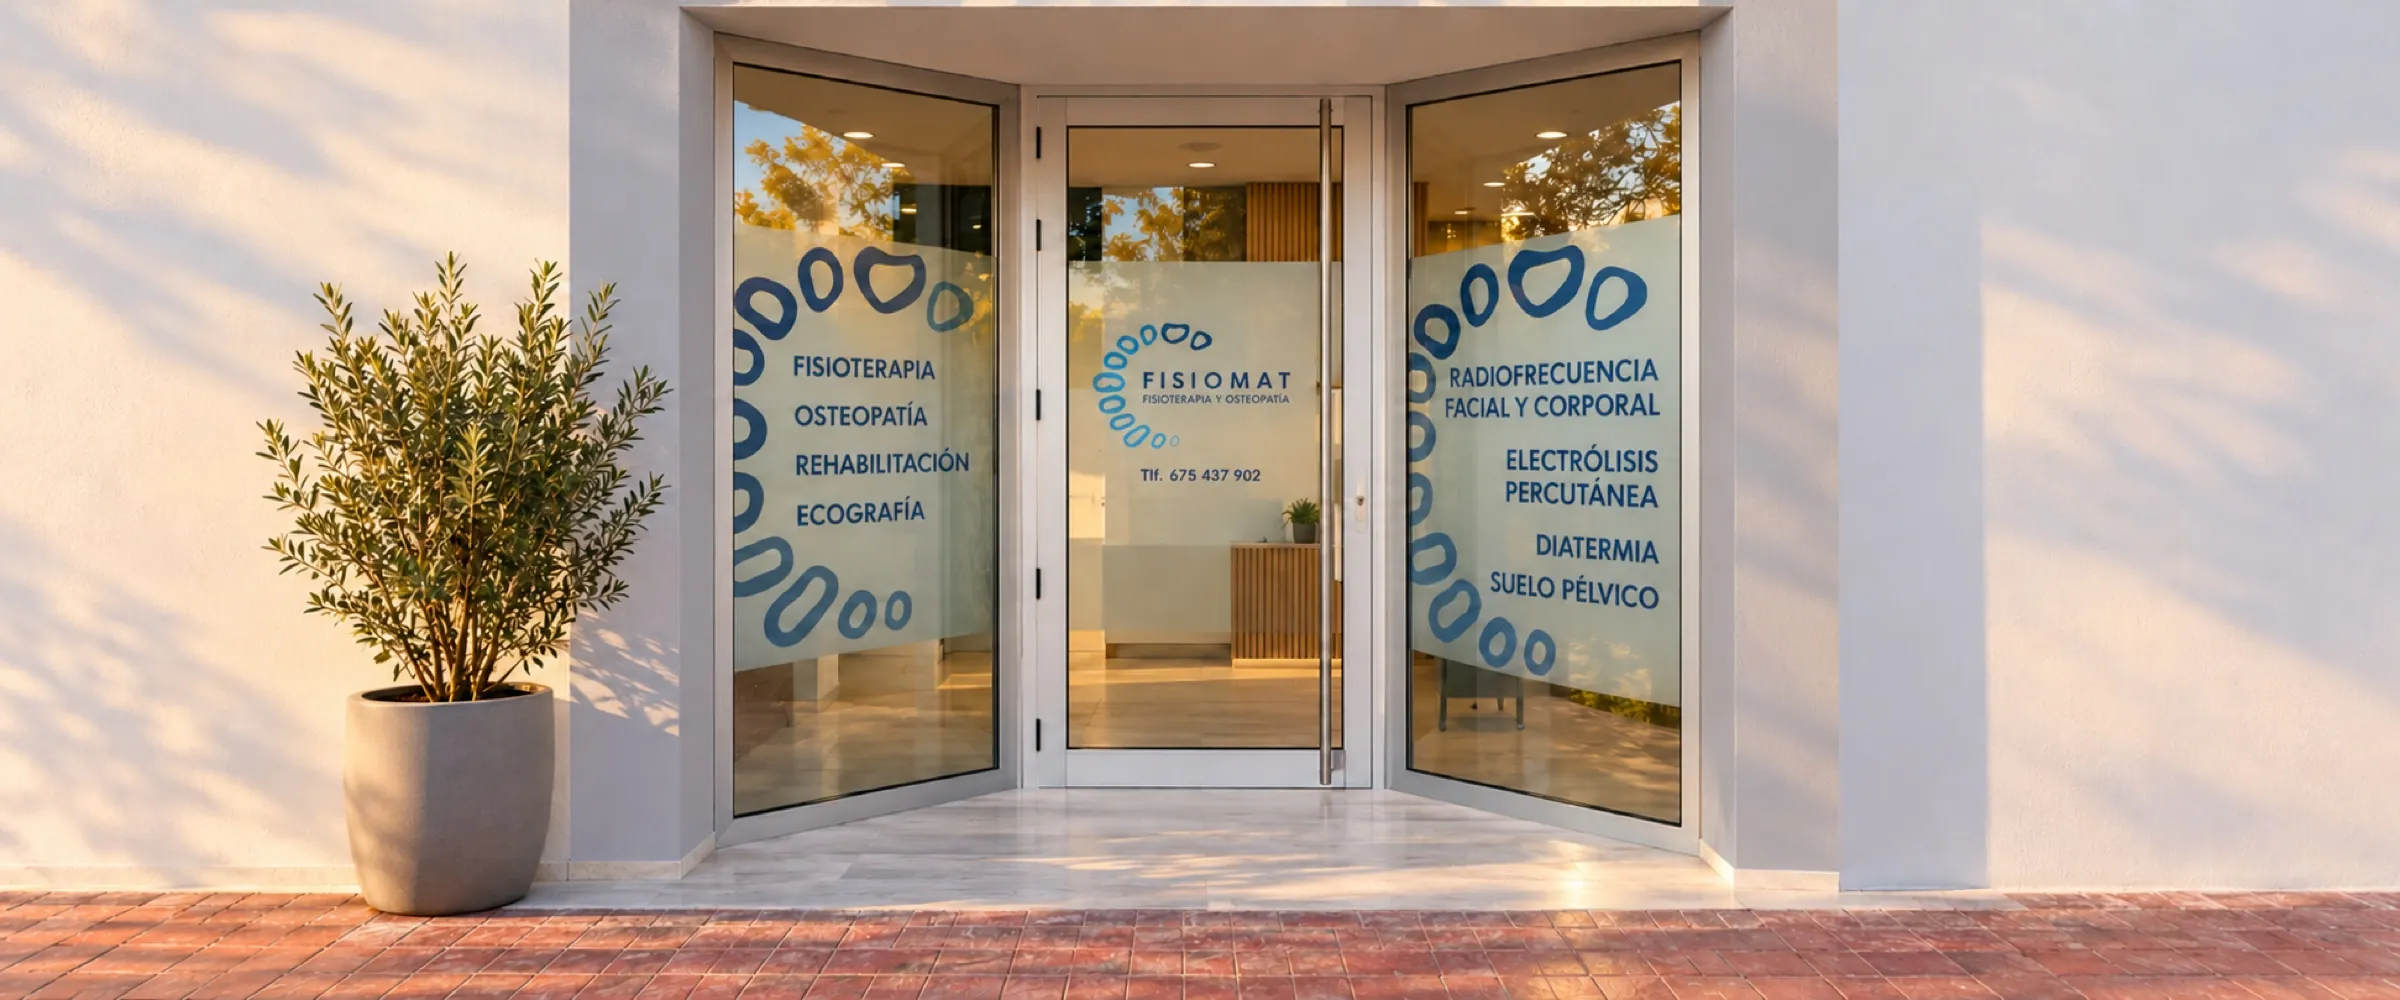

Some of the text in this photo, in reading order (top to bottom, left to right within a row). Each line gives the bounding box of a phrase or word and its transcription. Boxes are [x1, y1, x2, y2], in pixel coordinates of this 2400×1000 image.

[793, 355, 936, 380] FISIOTERAPIA
[1143, 371, 1291, 389] FISIOMAT
[1450, 358, 1659, 388] RADIOFRECUENCIA
[1142, 393, 1290, 404] FISIOTERAPIA Y OSTEOPATÍA
[1445, 393, 1660, 418] FACIAL Y CORPORAL
[794, 401, 928, 427] OSTEOPATÍA
[796, 447, 970, 476] REHABILITACIÓN
[1506, 444, 1659, 473] ELECTRÓLISIS
[1140, 468, 1261, 482] Tlf. 675 437 902
[1505, 477, 1659, 508] PERCUTÁNEA
[797, 496, 925, 527] ECOGRAFÍA
[1536, 533, 1659, 564] DIATERMIA
[1490, 571, 1659, 609] SUELO PÉLVICO
